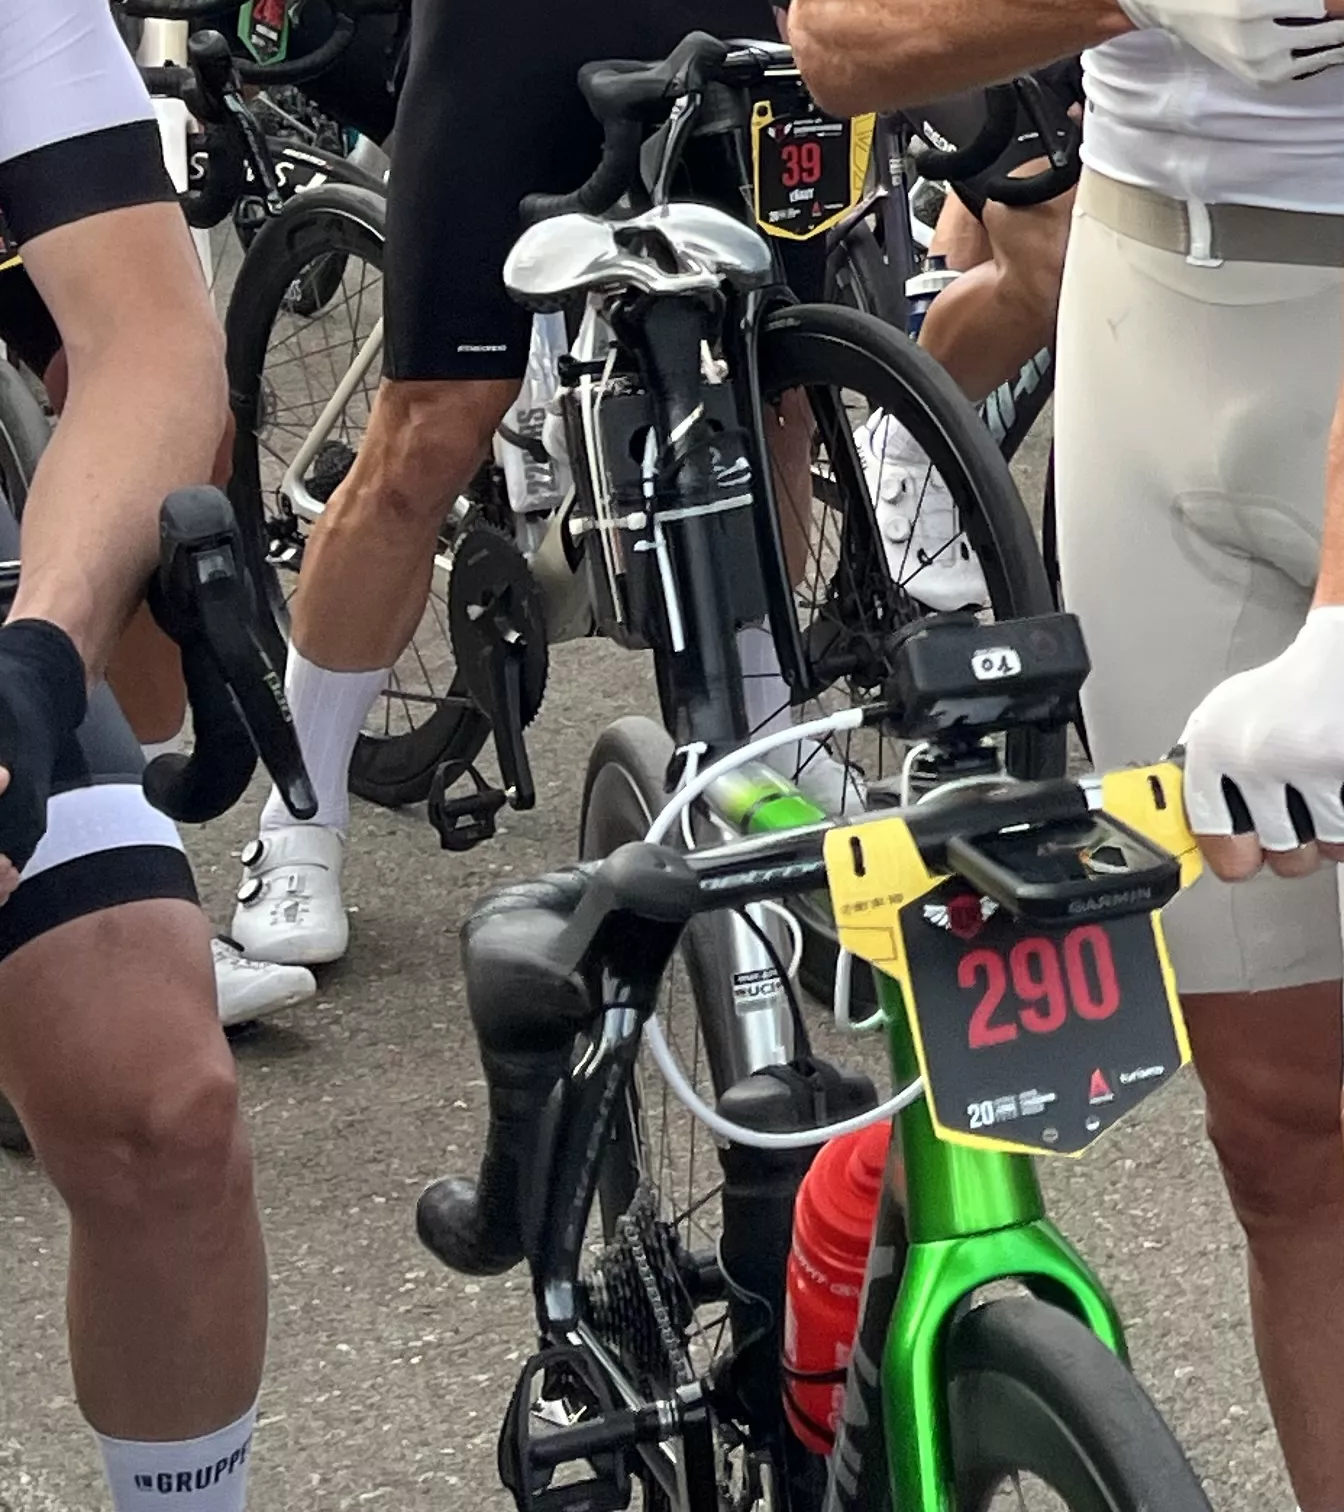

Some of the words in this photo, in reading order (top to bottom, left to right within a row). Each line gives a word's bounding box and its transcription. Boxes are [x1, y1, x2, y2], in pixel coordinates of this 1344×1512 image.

[781, 141, 822, 187] 39
[957, 922, 1121, 1050] 290
[966, 1099, 996, 1130] 20
